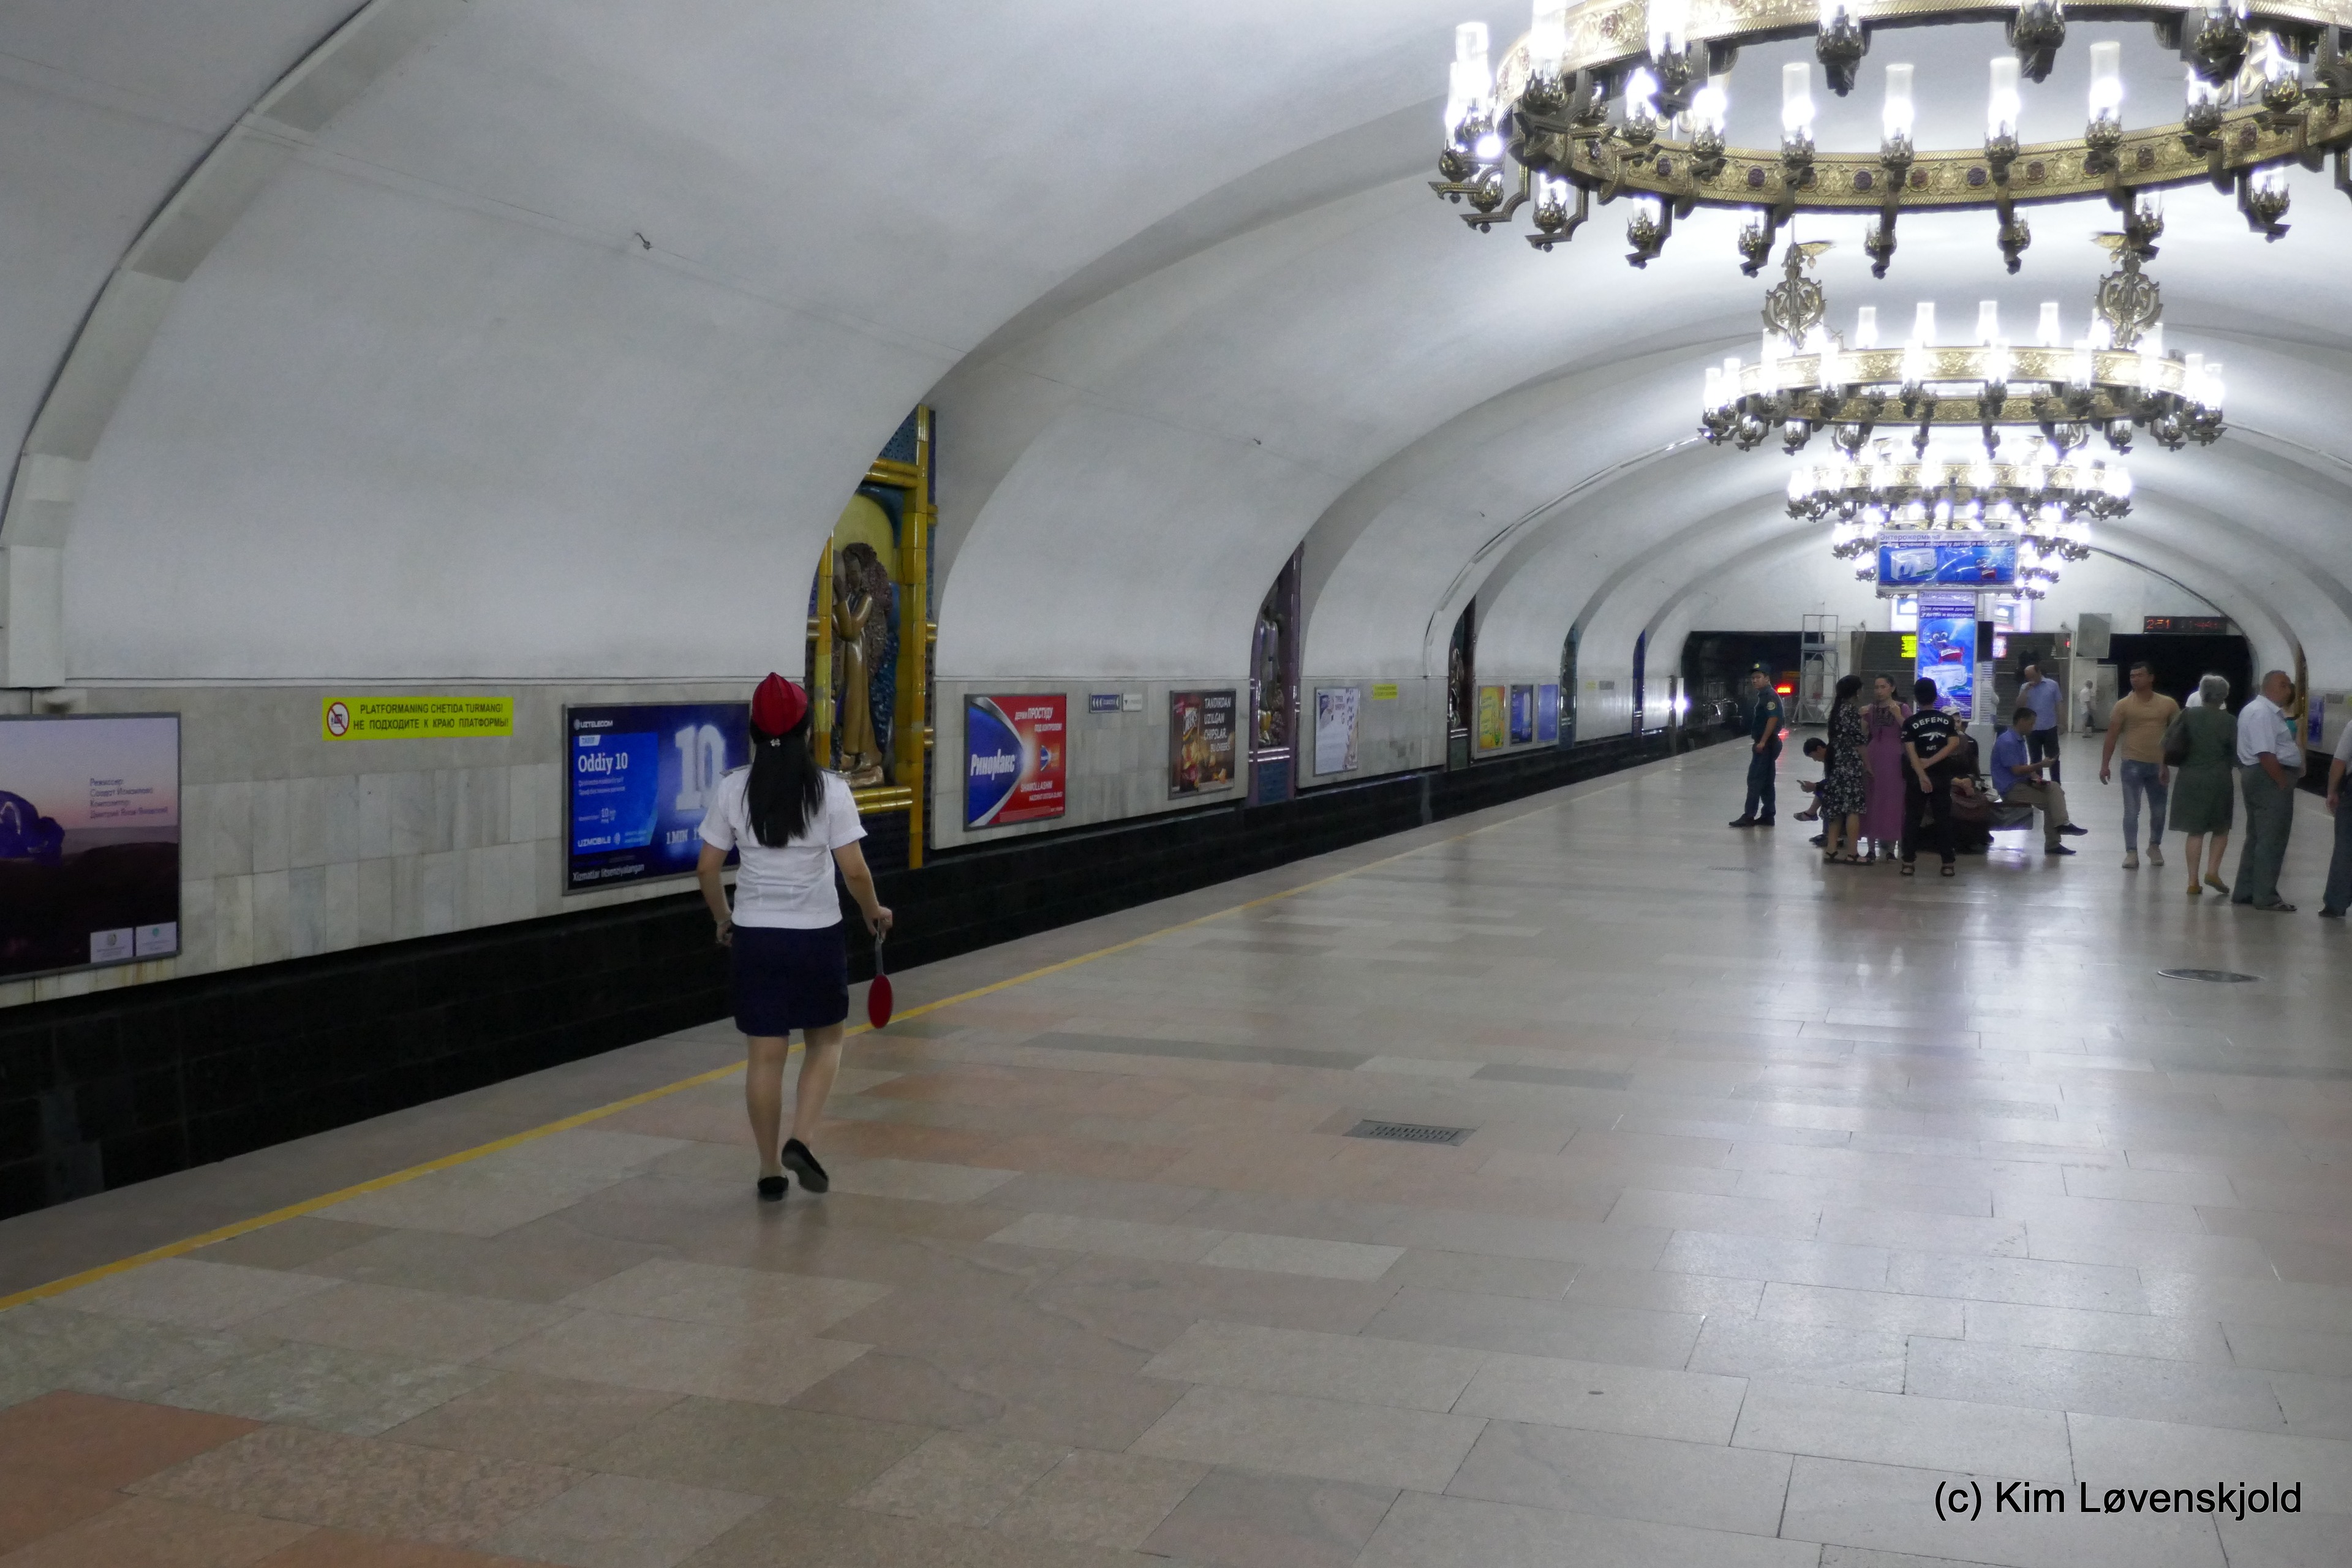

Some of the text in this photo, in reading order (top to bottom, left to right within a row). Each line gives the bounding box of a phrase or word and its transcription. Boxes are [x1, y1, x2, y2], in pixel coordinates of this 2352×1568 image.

[360, 703, 503, 714] PLATFORMANING CHETIDA TURMANG!
[1027, 706, 1054, 720] ПРОСТУДУ
[353, 717, 509, 731] НЕ ПОДХОДИТЕ К КРАЮ ПЛАТФОРМЫ!
[1912, 717, 1949, 729] DEFEND
[578, 752, 628, 775] Oddiy 10
[675, 725, 726, 810] 10
[578, 835, 611, 848] UZMOBILE
